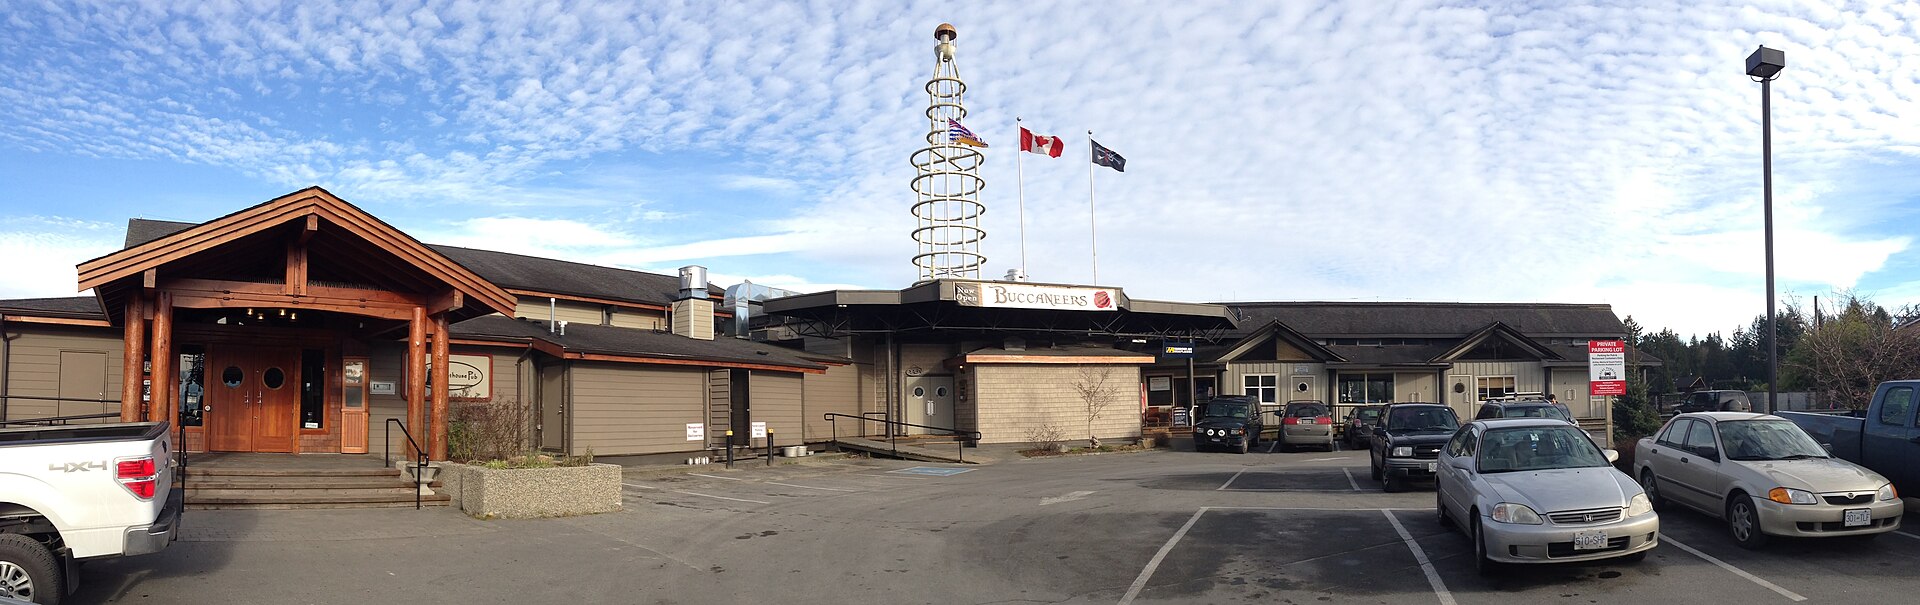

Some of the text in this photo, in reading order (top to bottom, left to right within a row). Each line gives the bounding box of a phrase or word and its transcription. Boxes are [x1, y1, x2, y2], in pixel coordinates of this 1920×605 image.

[956, 286, 975, 294] Now
[956, 294, 977, 302] Open
[989, 286, 1088, 306] BUCCANEERS
[467, 370, 478, 380] Pub
